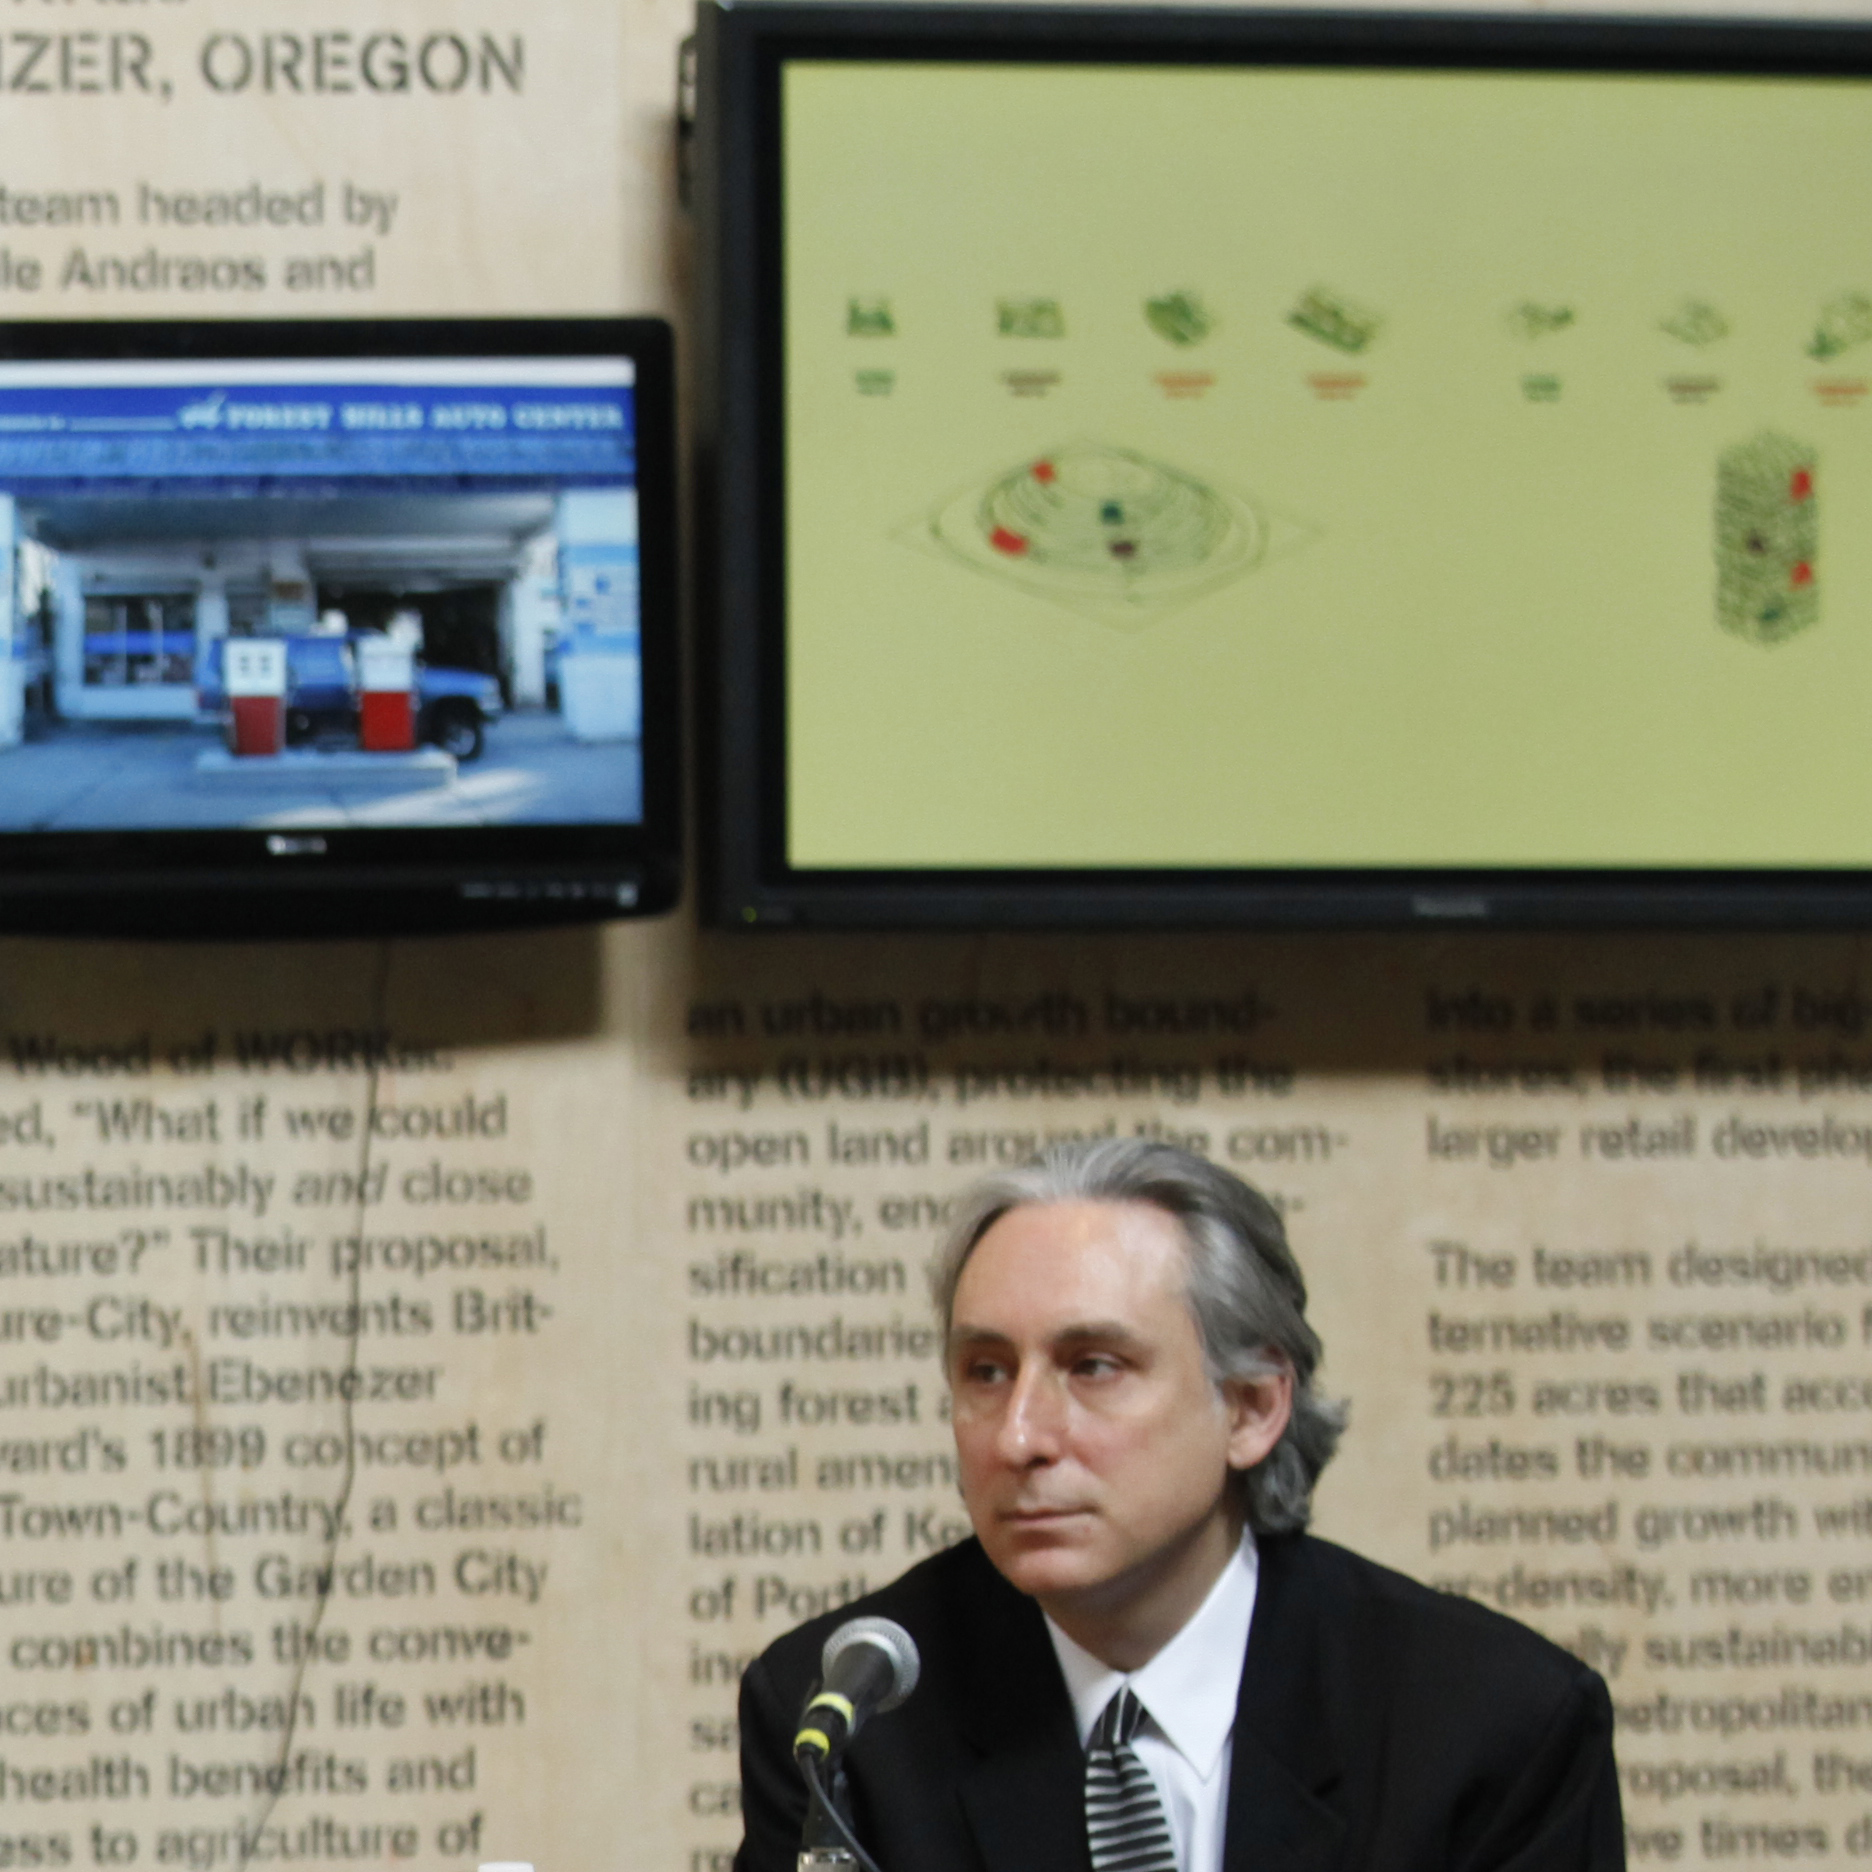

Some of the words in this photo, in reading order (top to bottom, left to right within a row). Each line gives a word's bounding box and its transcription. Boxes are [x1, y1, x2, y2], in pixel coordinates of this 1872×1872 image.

[198, 31, 525, 94] OREGON
[136, 181, 326, 227] headed
[341, 182, 399, 237] by
[58, 247, 268, 291] Andraos
[282, 246, 376, 291] and
[685, 1131, 811, 1173] open
[826, 1120, 929, 1166] land
[1425, 1114, 1562, 1170] larger
[1579, 1112, 1697, 1160] retail
[292, 1163, 390, 1201] and
[399, 1159, 534, 1206] close
[688, 1249, 907, 1296] sification
[208, 1298, 435, 1340] reinvents
[451, 1288, 553, 1337] Brit-
[1425, 1309, 1631, 1355] ternative
[1647, 1310, 1848, 1350] scenario
[687, 1387, 762, 1435] ing
[777, 1378, 920, 1427] forest
[1428, 1369, 1518, 1419] 225
[1530, 1380, 1662, 1417] acres
[1675, 1371, 1768, 1413] that
[367, 1498, 399, 1533] a
[412, 1483, 582, 1532] classic
[688, 1512, 823, 1558] lation
[837, 1508, 887, 1554] of
[108, 1688, 157, 1733] of
[174, 1688, 317, 1733] urban
[333, 1681, 407, 1730] life
[422, 1678, 526, 1728] with
[1699, 1817, 1831, 1859] times
